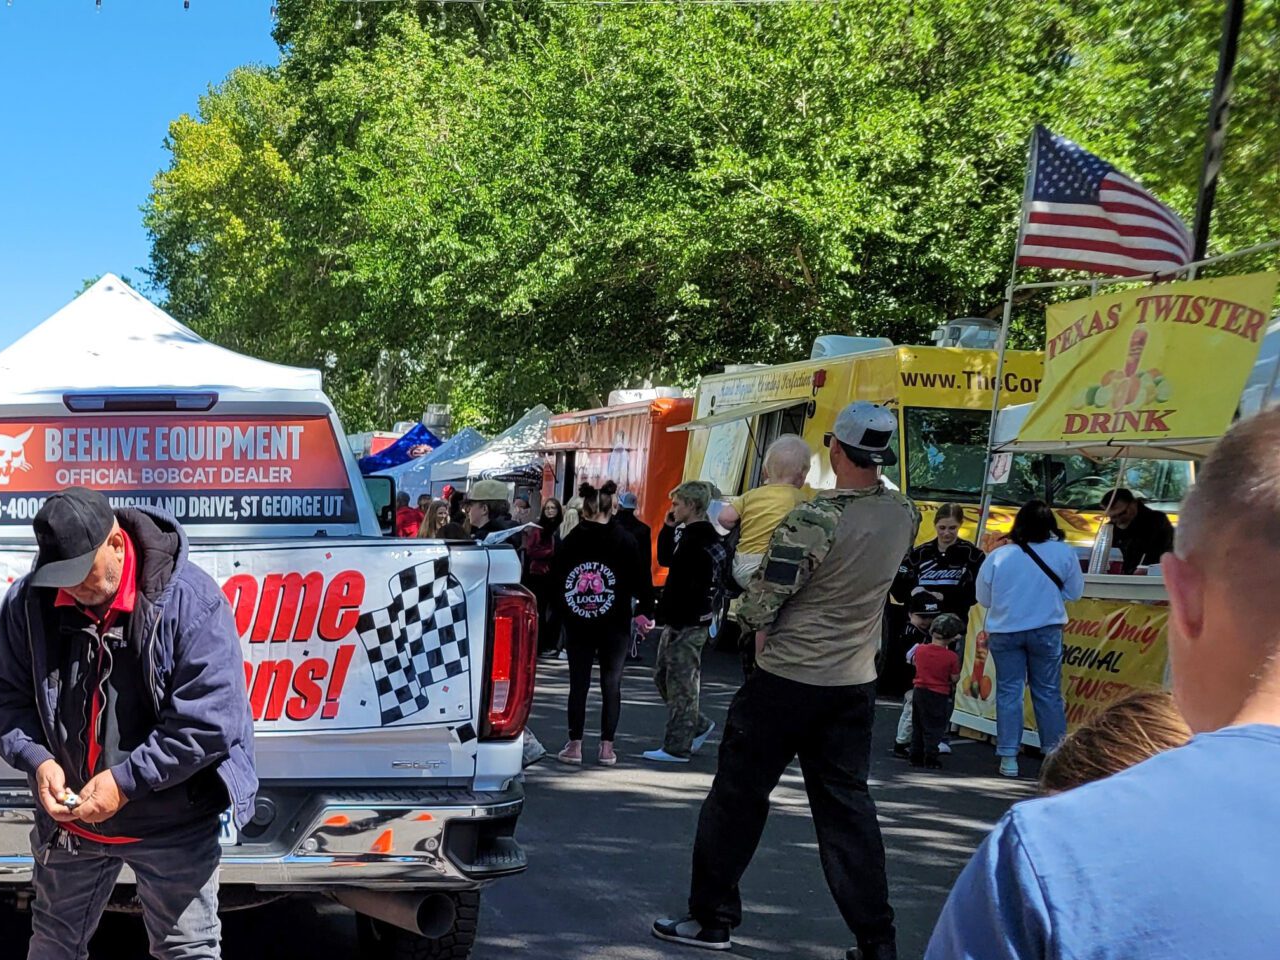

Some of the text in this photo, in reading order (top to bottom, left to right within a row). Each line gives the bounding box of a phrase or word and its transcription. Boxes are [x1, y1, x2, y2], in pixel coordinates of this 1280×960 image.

[1048, 294, 1267, 361] TEXAS TWISTER
[1062, 409, 1178, 434] DRINK
[44, 425, 304, 462] BEEHIVE EQUIPMENT
[55, 467, 292, 485] OFFICIAL BOBCAT DEALER
[188, 496, 238, 520] DRIVE,
[240, 496, 260, 517] ST
[261, 496, 322, 517] GEORGE
[324, 496, 345, 516] UT
[564, 561, 616, 590] SUPPORT YOUR
[221, 569, 366, 643] ome
[565, 595, 598, 619] SPOOKY
[576, 594, 606, 604] LOCAL
[1106, 612, 1160, 655] Only
[392, 760, 447, 769] SLT
